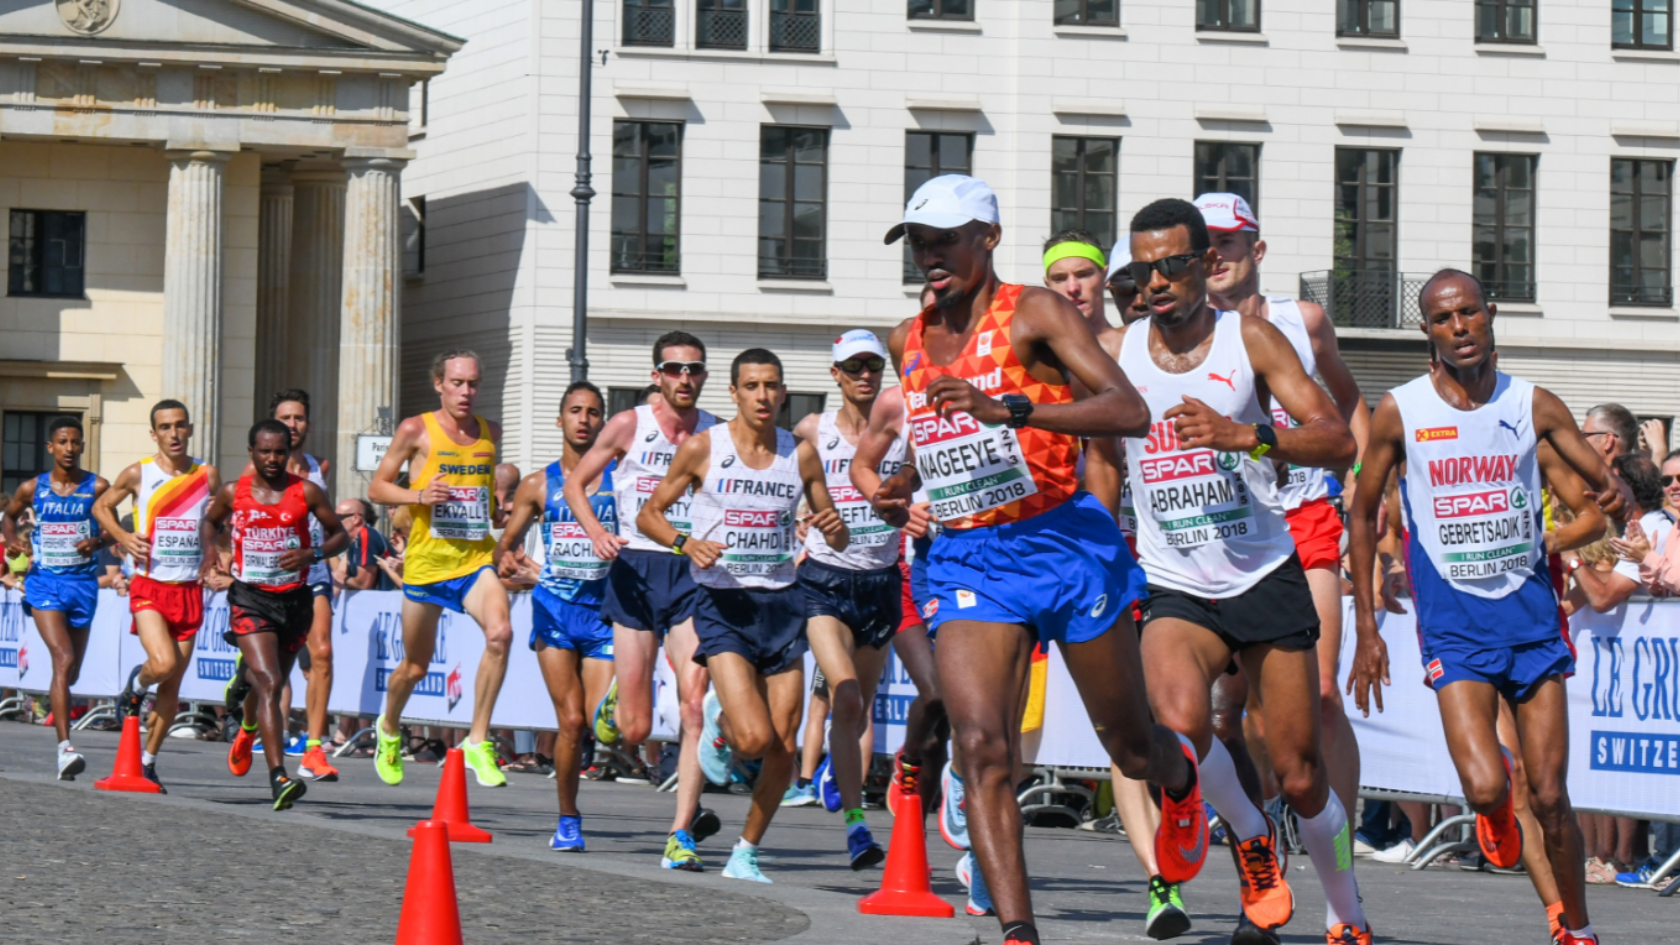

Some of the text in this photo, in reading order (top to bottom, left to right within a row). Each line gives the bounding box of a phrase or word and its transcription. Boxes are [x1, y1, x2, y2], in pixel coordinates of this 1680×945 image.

[914, 412, 977, 442] SPAR
[1431, 429, 1457, 438] EXTRA
[1001, 430, 1019, 465] 273
[919, 438, 1001, 481] NAGEEYE
[1142, 454, 1214, 480] SPAR
[439, 463, 491, 475] SWEDEN
[1429, 455, 1518, 487] NORWAY
[448, 488, 477, 500] PAR
[733, 479, 796, 499] FRANCE
[945, 482, 965, 496] RUN
[966, 476, 999, 491] CLEAN
[935, 482, 1026, 518] BERLIN 2018
[1151, 479, 1234, 513] ABRAHAM
[1435, 492, 1507, 515] SPAR
[42, 502, 84, 515] ITALIA
[434, 503, 482, 519] EKVALL
[157, 520, 197, 530] SPAR
[726, 511, 778, 526] SPAR
[1173, 518, 1194, 528] RUN
[1195, 513, 1227, 525] CLEAN
[1523, 510, 1531, 540] 274
[42, 525, 77, 534] SPAR
[1213, 521, 1247, 539] 2018
[1438, 515, 1520, 546] GEBRETSADIK
[158, 535, 200, 548] ESPAÑA
[245, 541, 284, 550] SPAR
[725, 531, 783, 549] CHAHDI
[1466, 551, 1487, 561] RUN
[726, 562, 763, 573] BERLIN
[1450, 555, 1528, 578] BERLIN 2018
[1590, 637, 1625, 718] LE
